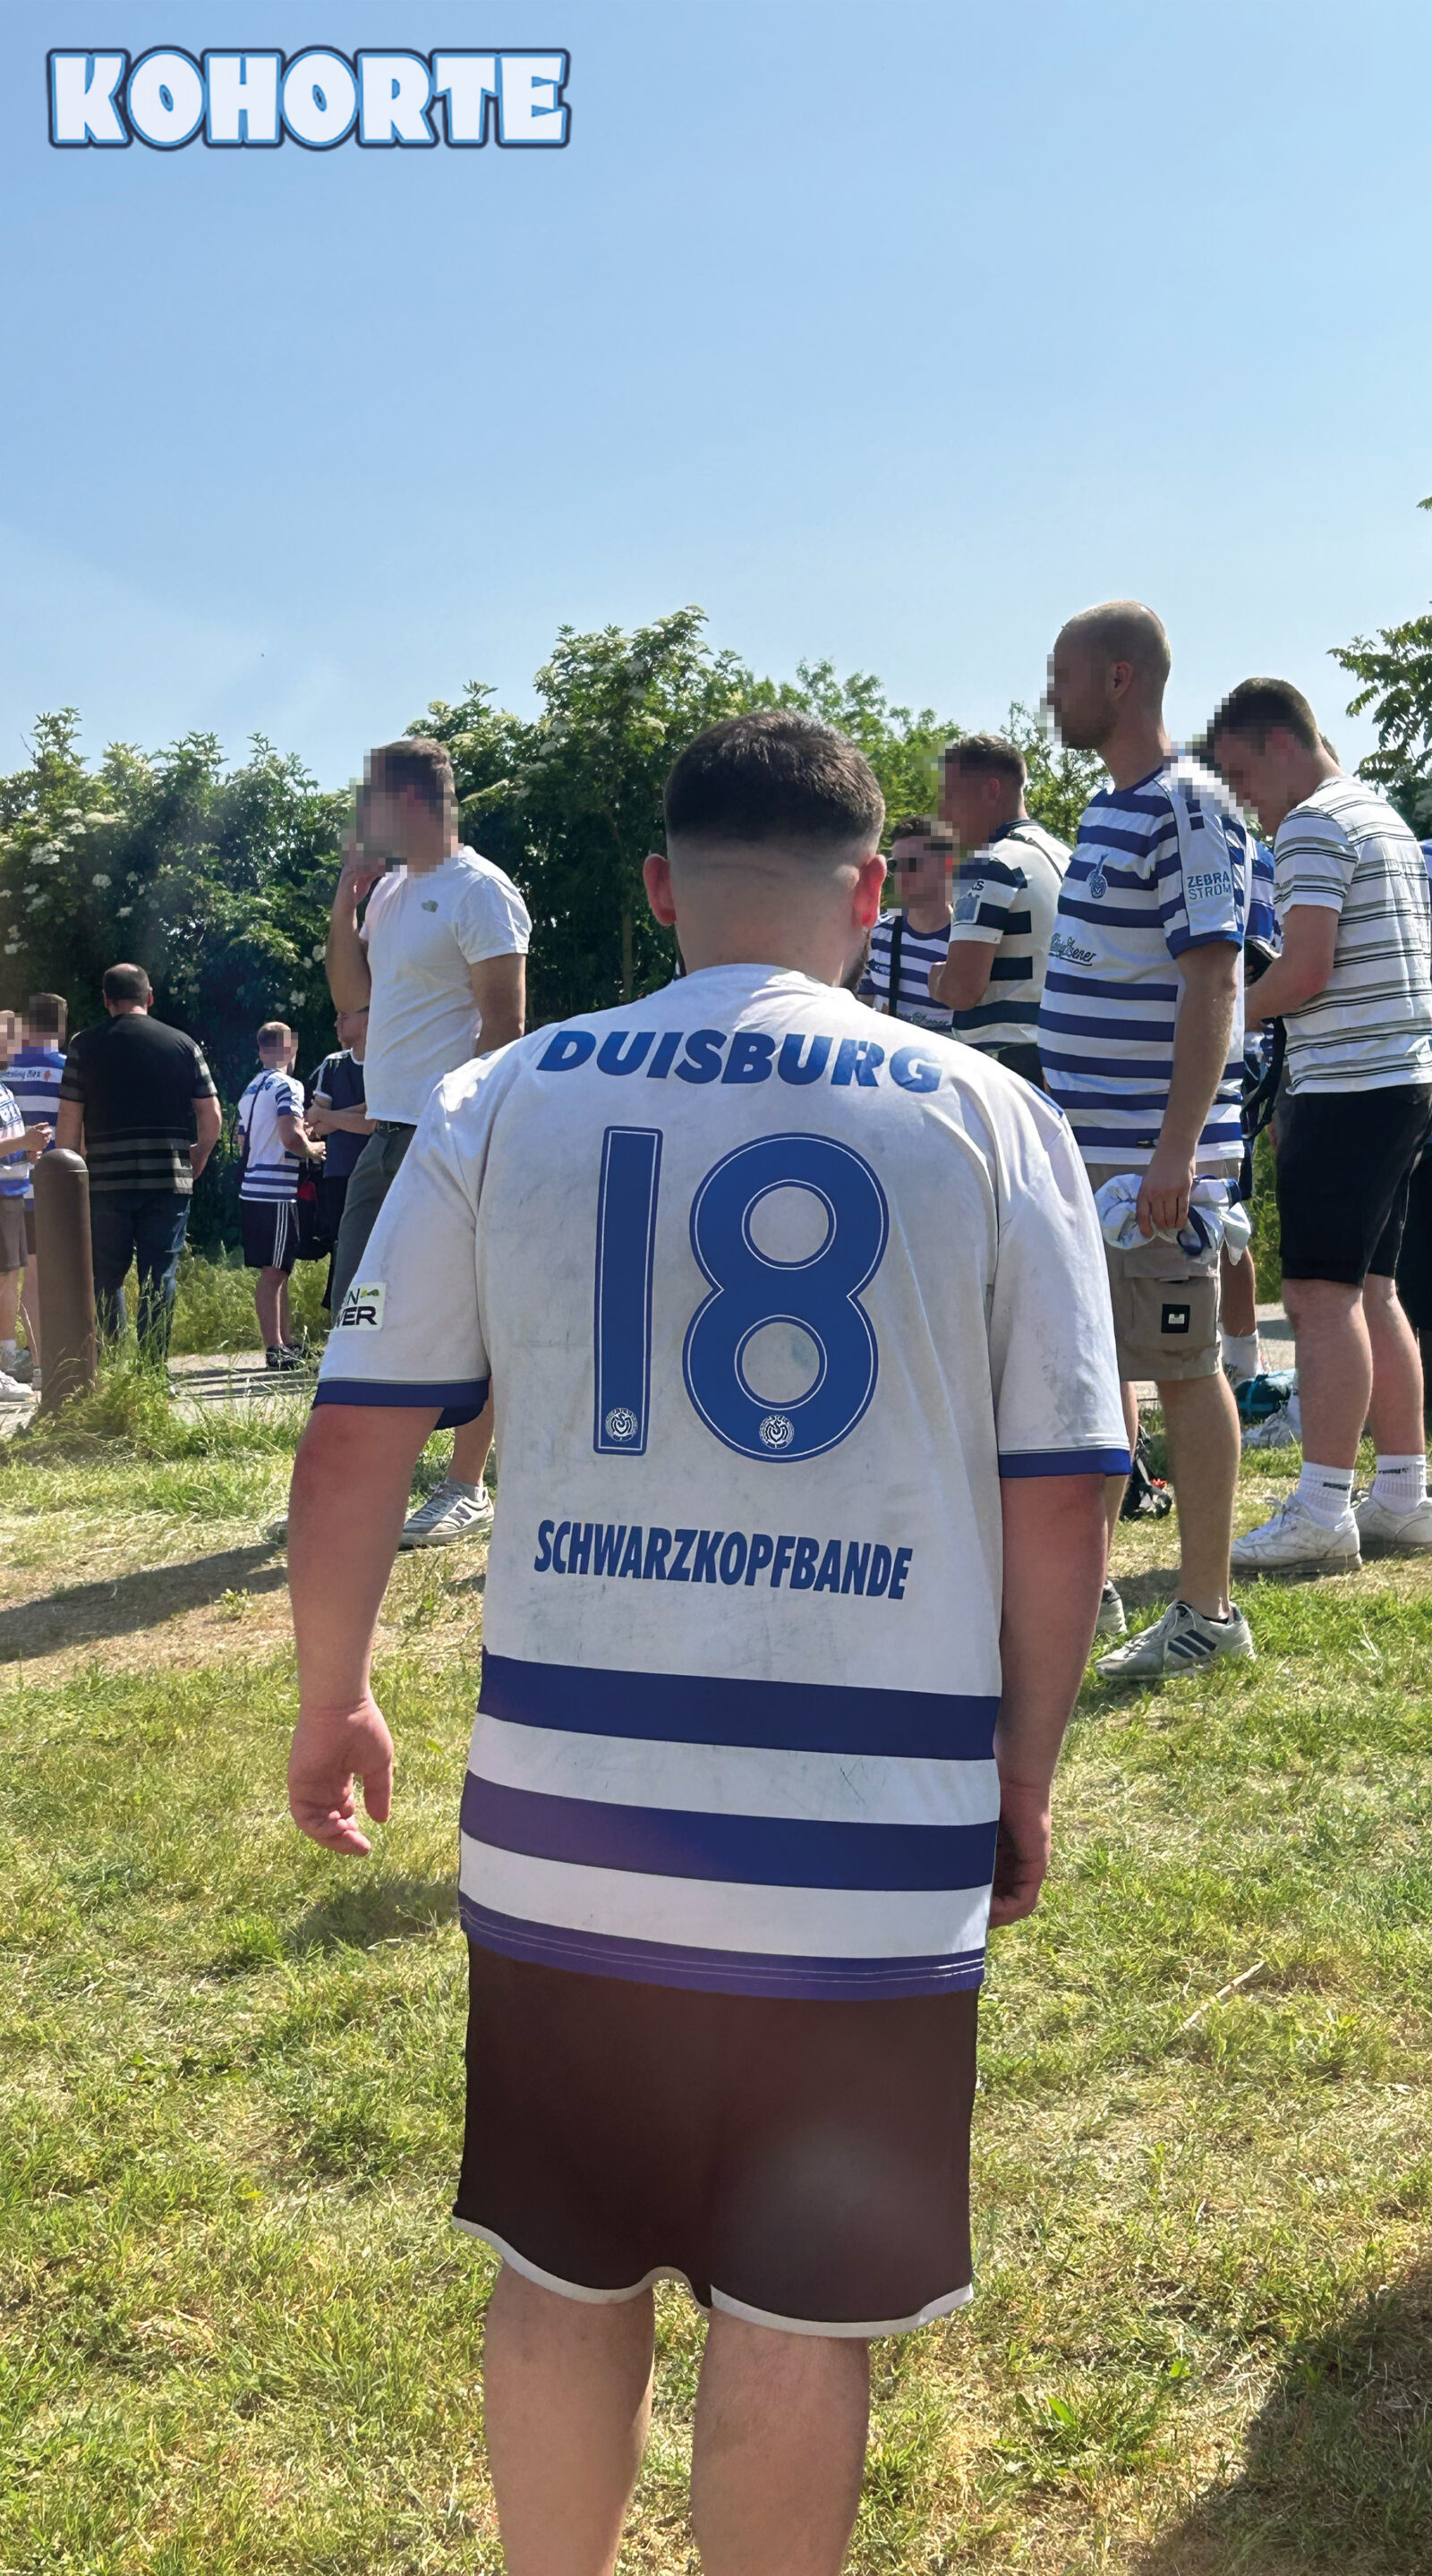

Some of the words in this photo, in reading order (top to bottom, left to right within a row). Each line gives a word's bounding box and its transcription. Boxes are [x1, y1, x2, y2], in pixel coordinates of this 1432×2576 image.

[1187, 871, 1231, 888] ZEBRA
[1188, 883, 1232, 900] STROM
[536, 1029, 942, 1093] DUISBURG
[593, 1126, 890, 1464] 18
[534, 1519, 913, 1600] SCHWARZKOPFBANDE
